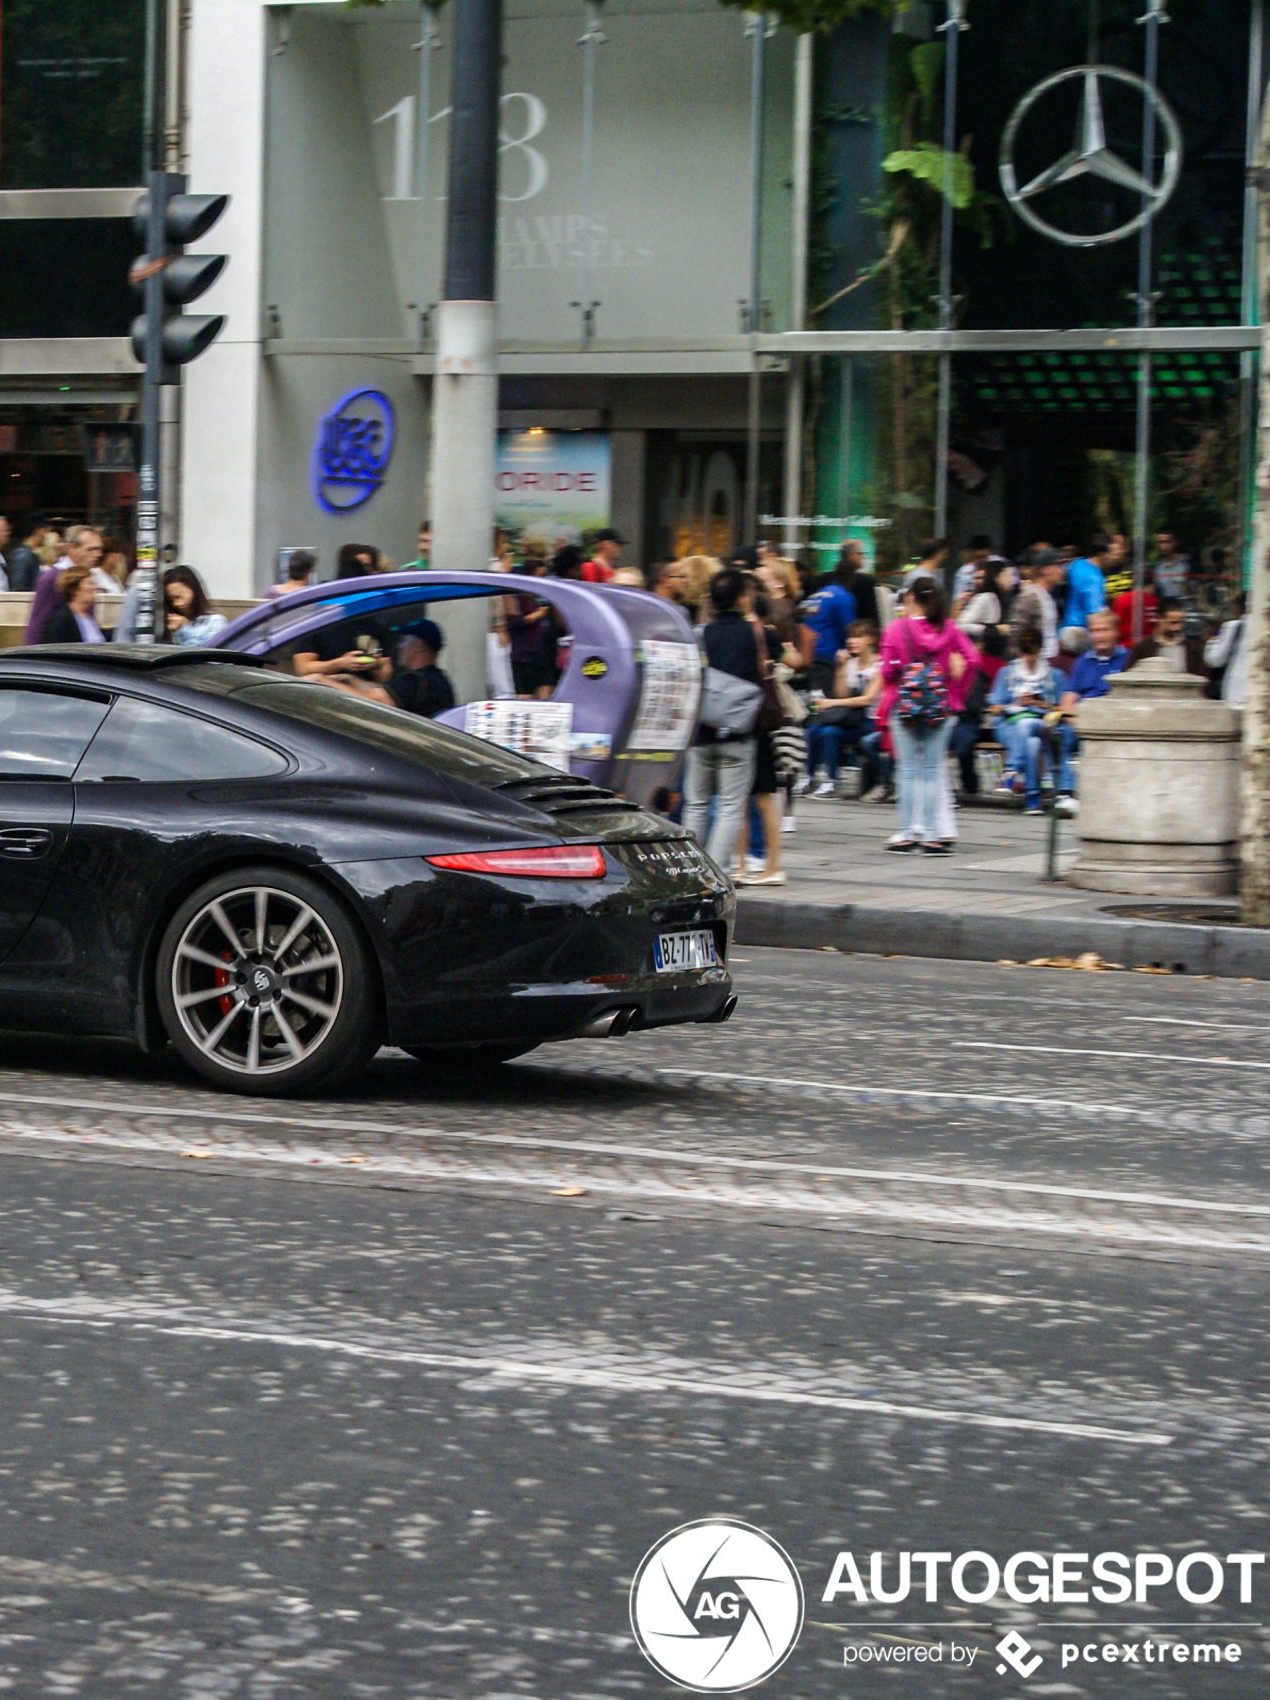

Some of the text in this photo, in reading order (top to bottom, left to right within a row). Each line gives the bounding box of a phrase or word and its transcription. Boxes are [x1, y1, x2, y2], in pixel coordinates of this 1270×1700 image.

[373, 91, 549, 201] 18
[497, 215, 608, 245] AMPS
[493, 471, 597, 491] ORIDE
[661, 933, 711, 966] BZ-77-TV
